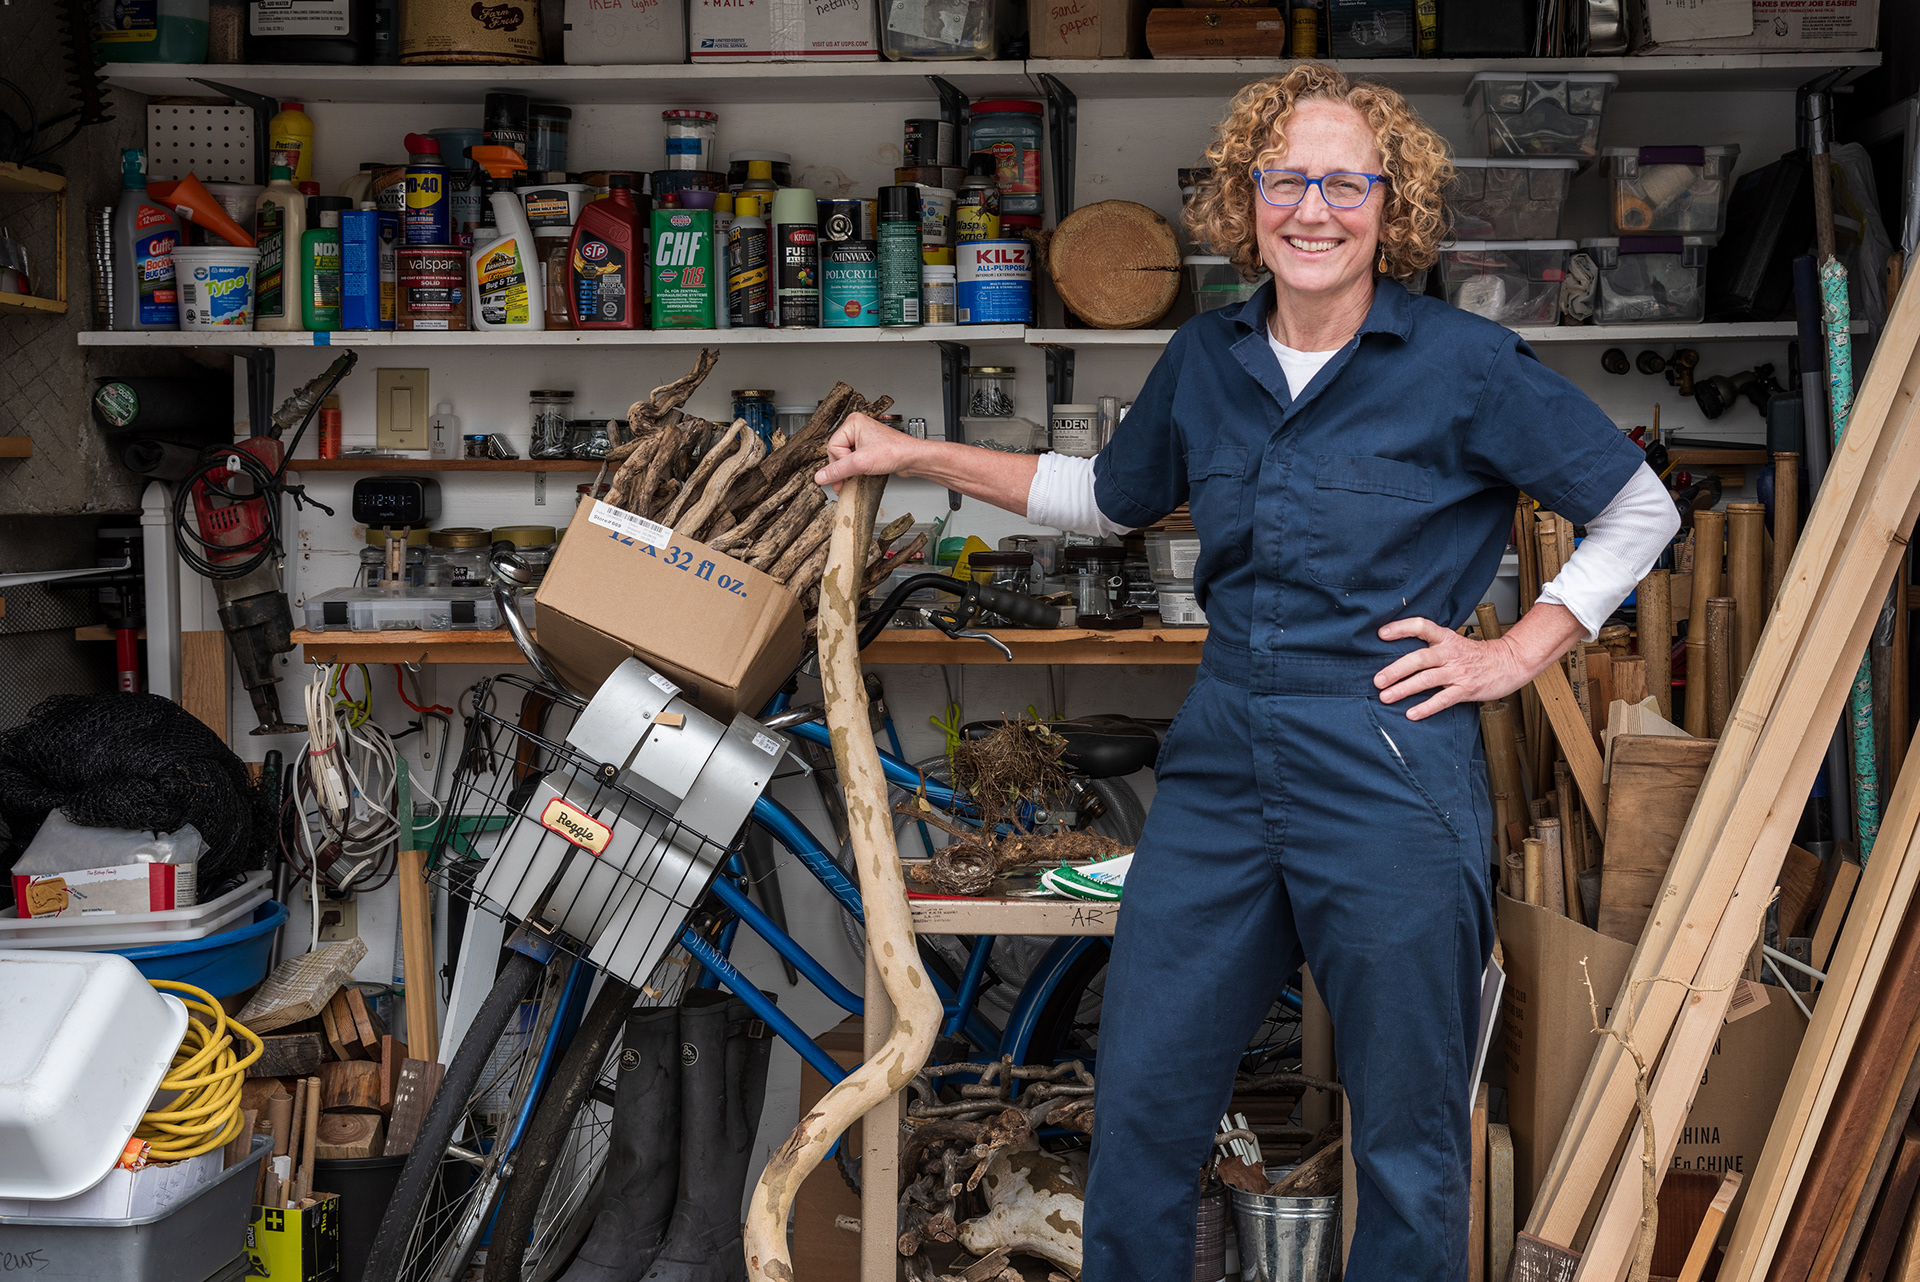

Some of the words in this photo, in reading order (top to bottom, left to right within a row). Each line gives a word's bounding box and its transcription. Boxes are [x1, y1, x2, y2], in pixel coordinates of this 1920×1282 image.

[589, 0, 622, 10] IKEA
[816, 0, 859, 15] netting
[1051, 0, 1087, 20] sand-
[479, 8, 509, 20] Farm
[489, 14, 520, 28] Fresh
[1060, 16, 1098, 45] paper
[450, 181, 469, 191] WAX
[150, 214, 166, 222] WEEKS
[314, 243, 340, 256] NOX
[585, 244, 605, 258] STP
[655, 232, 703, 266] CHF
[785, 247, 816, 256] FUSIO
[976, 249, 1026, 264] KILZ
[146, 258, 174, 271] Backy
[314, 256, 321, 266] 7
[409, 256, 455, 273] valspar
[834, 252, 872, 262] MINWAX
[506, 275, 519, 284] Tar
[681, 267, 706, 285] 11S
[826, 269, 878, 280] POLYCRYLI
[204, 276, 245, 298] Type
[245, 271, 252, 285] 1
[579, 280, 592, 315] HIGH
[369, 494, 405, 507] 12:41
[664, 546, 694, 573] 32
[694, 559, 716, 583] fl
[718, 573, 749, 599] oz.
[556, 811, 595, 842] Reggie
[683, 928, 739, 981] OLUMBIA
[1697, 1155, 1744, 1174] CHINE
[248, 1225, 257, 1249] RYOBI
[0, 1249, 50, 1273] ews
